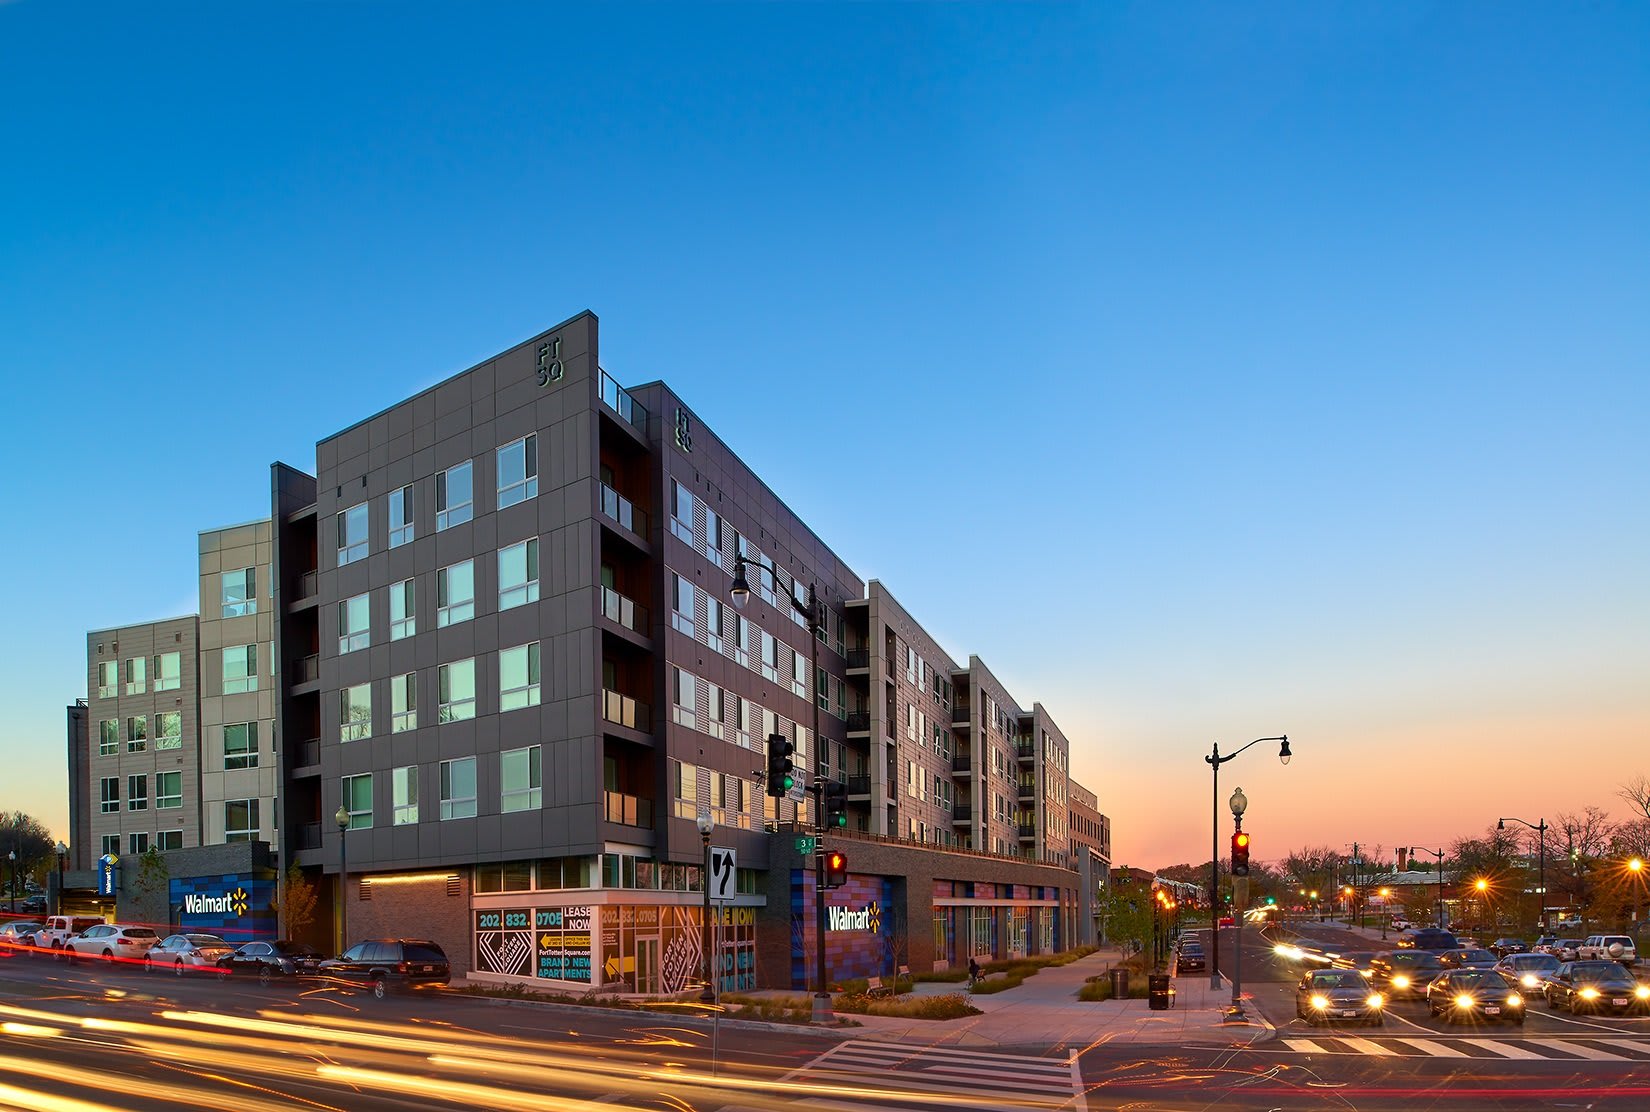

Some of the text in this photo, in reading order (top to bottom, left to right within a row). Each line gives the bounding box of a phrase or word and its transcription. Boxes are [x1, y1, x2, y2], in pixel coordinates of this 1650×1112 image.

[538, 336, 561, 366] FT
[538, 360, 563, 387] SQ
[185, 892, 233, 914] Walmart
[536, 912, 562, 926] 0705
[564, 907, 591, 918] LEASE
[829, 906, 870, 931] Walmart
[569, 919, 591, 930] NOW
[541, 957, 591, 968] BRAND NEW
[538, 969, 591, 979] APARTMENTS
